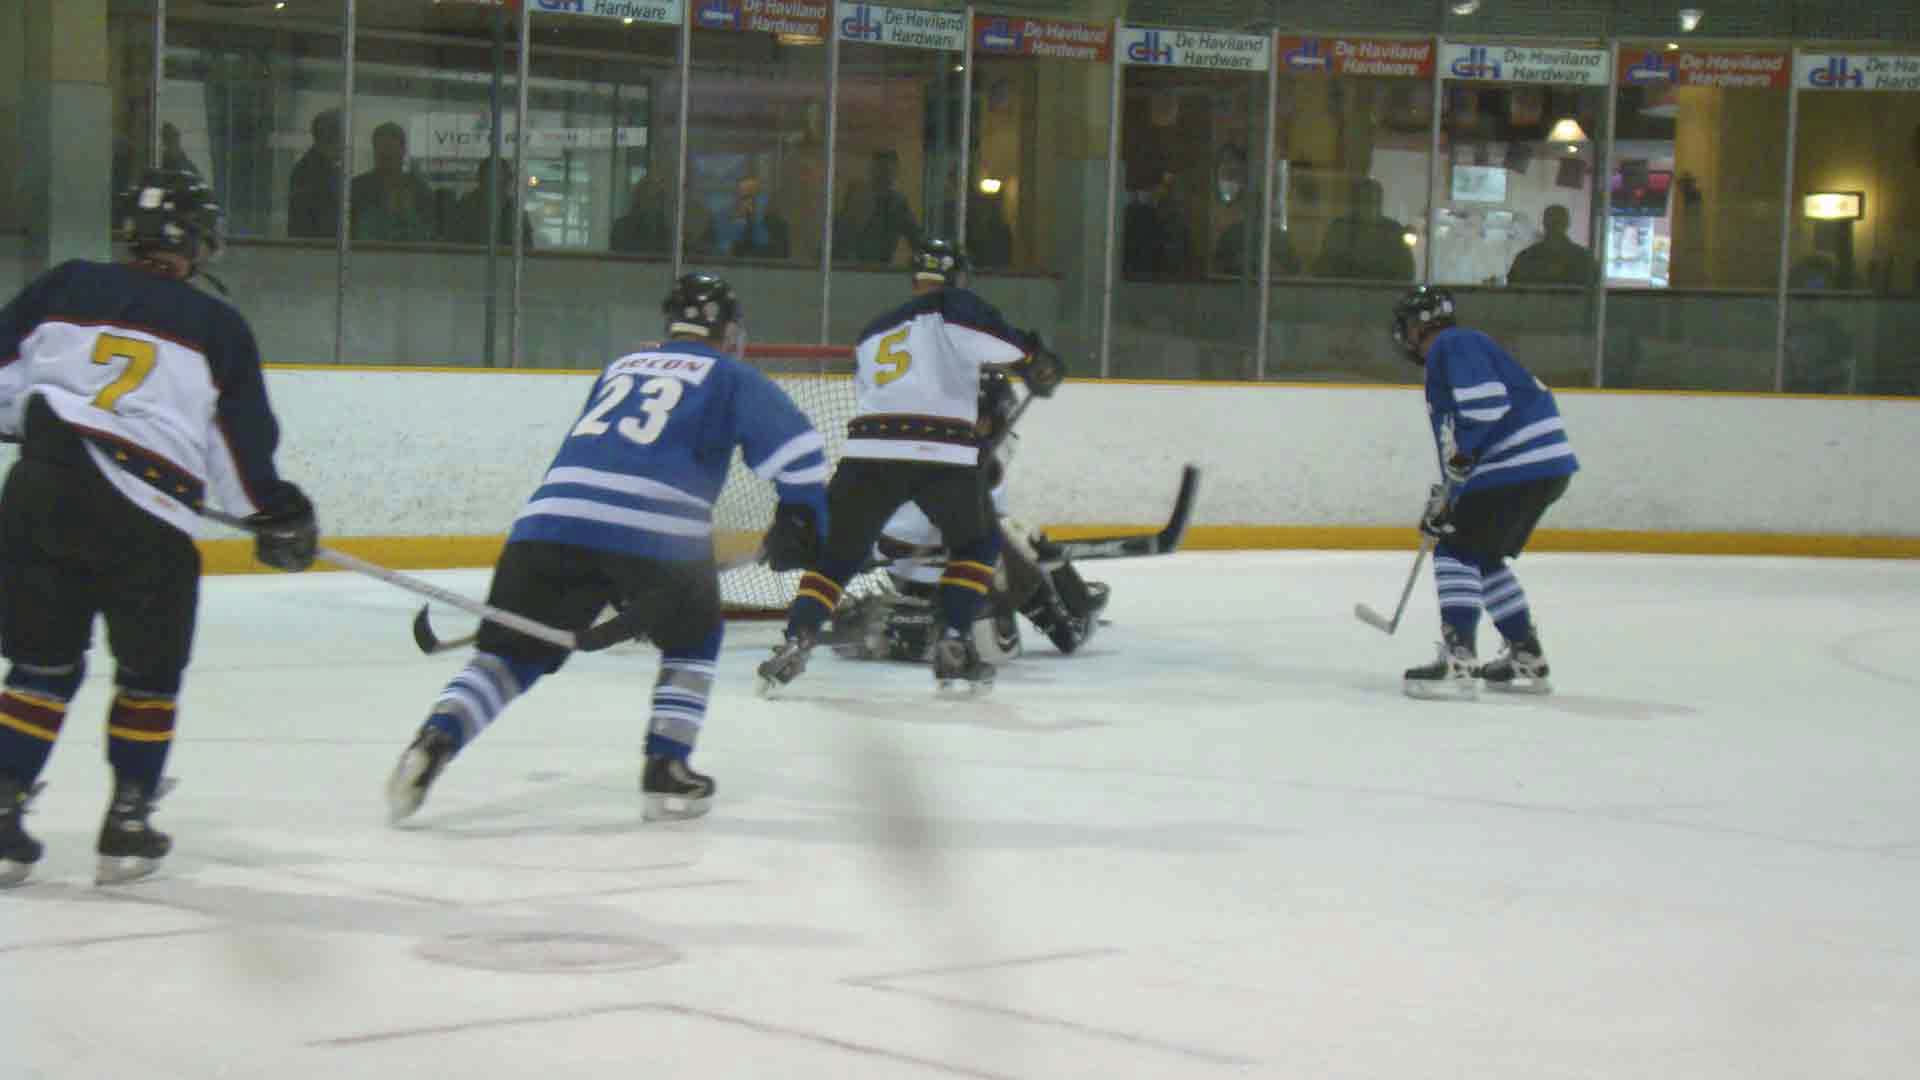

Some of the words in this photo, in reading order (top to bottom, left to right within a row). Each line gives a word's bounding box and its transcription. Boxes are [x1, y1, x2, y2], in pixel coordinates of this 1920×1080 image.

[594, 0, 666, 19] Hardware
[885, 9, 904, 25] De
[891, 28, 955, 48] Hardware
[1175, 32, 1197, 49] De
[1183, 52, 1254, 67] Hardware
[1504, 48, 1523, 64] De
[1866, 56, 1888, 72] De
[1511, 66, 1592, 82] Hardware
[875, 327, 911, 385] 5
[90, 332, 158, 415] 7
[571, 373, 683, 444] 23
